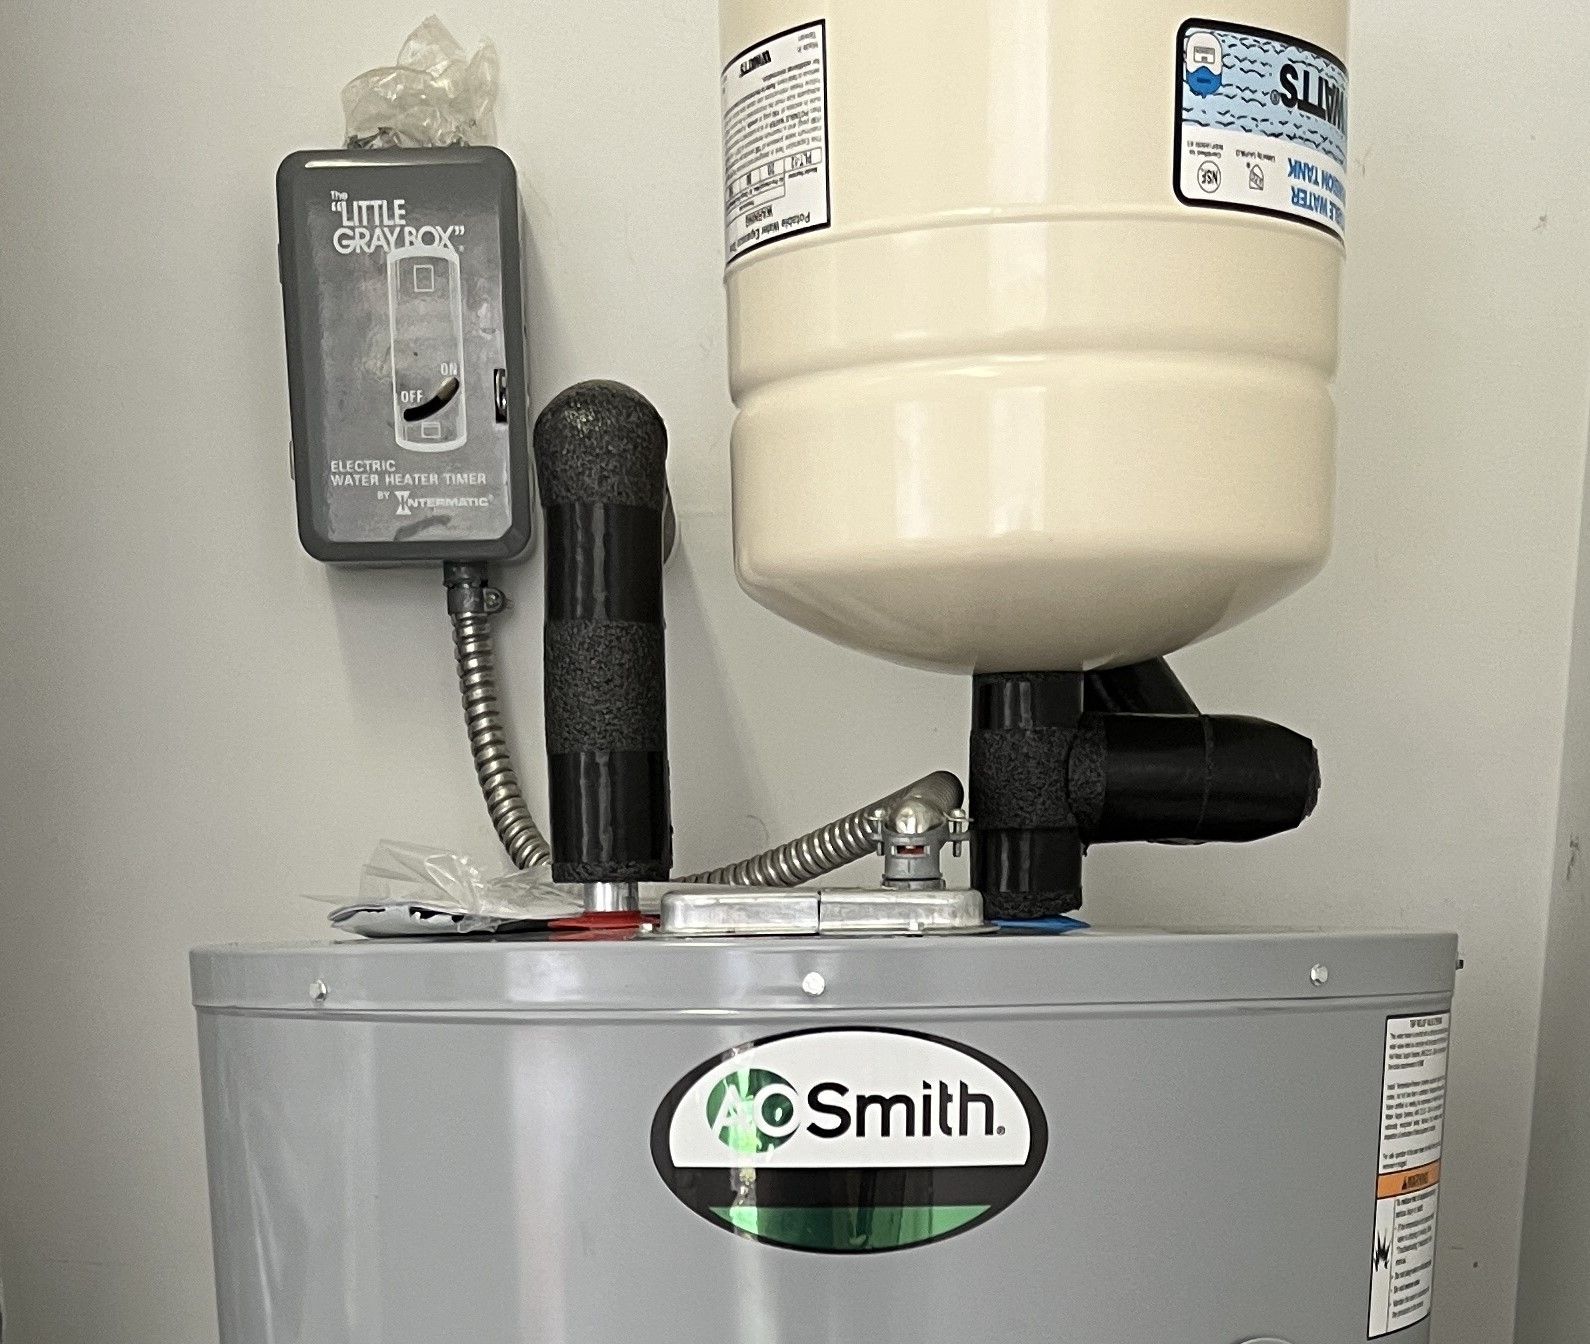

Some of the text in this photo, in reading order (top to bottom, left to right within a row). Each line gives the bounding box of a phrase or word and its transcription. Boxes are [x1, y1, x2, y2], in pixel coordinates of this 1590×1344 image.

[1202, 170, 1218, 185] NSF
[1287, 157, 1319, 186] TANK
[331, 191, 348, 200] The
[1290, 185, 1328, 219] WATER
[333, 226, 400, 254] GRAY
[441, 363, 457, 375] ON
[401, 390, 423, 402] OFF
[331, 460, 396, 472] ELECTRIC
[332, 473, 486, 486] WATER HEATER TIMER
[377, 491, 390, 499] BY
